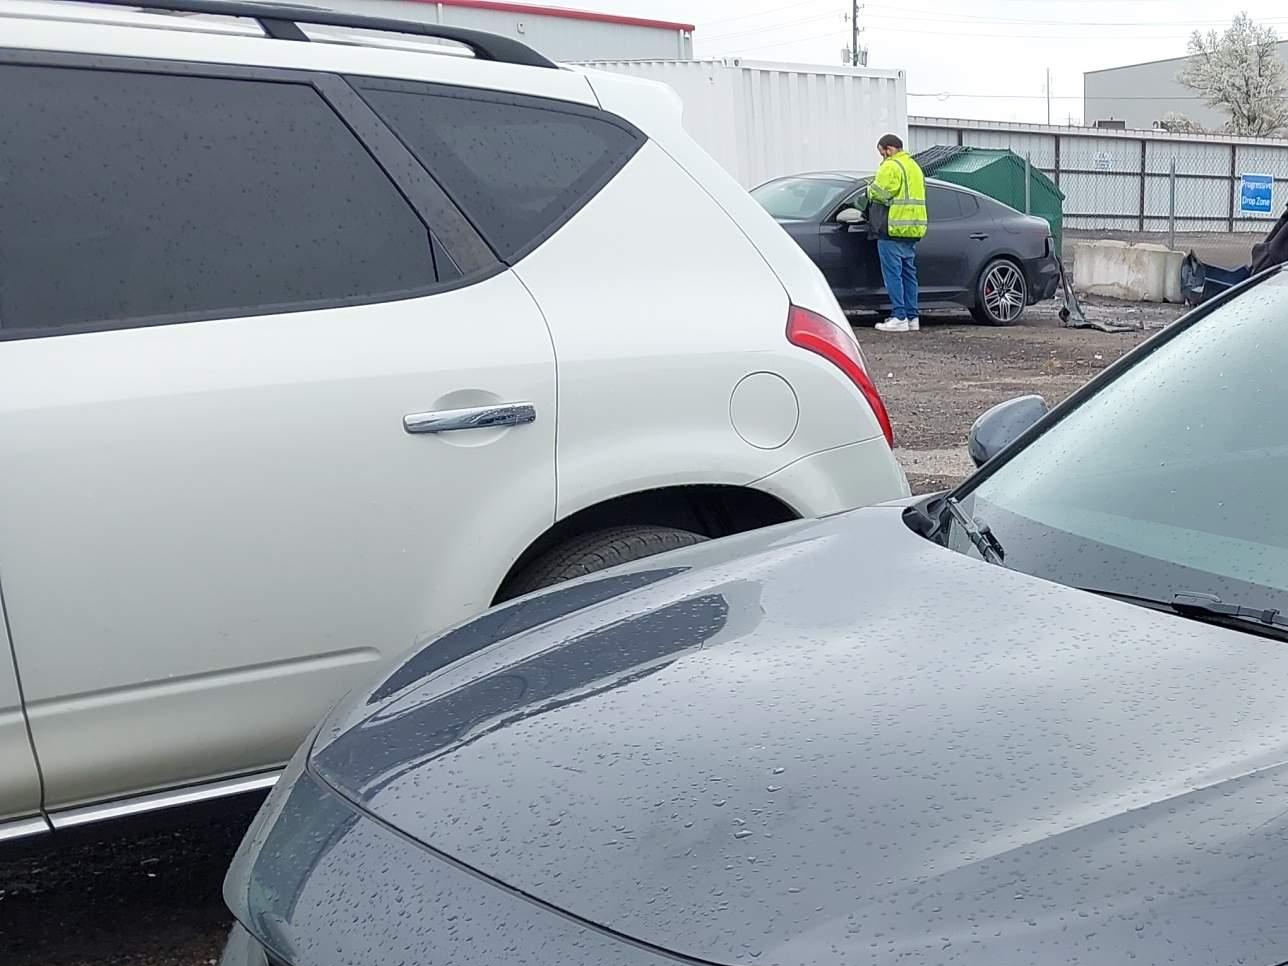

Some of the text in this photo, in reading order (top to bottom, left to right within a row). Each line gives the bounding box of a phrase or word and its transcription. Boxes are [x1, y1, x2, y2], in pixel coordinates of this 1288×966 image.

[1241, 180, 1272, 190] Progressive
[1242, 196, 1270, 206] Drop Zone
